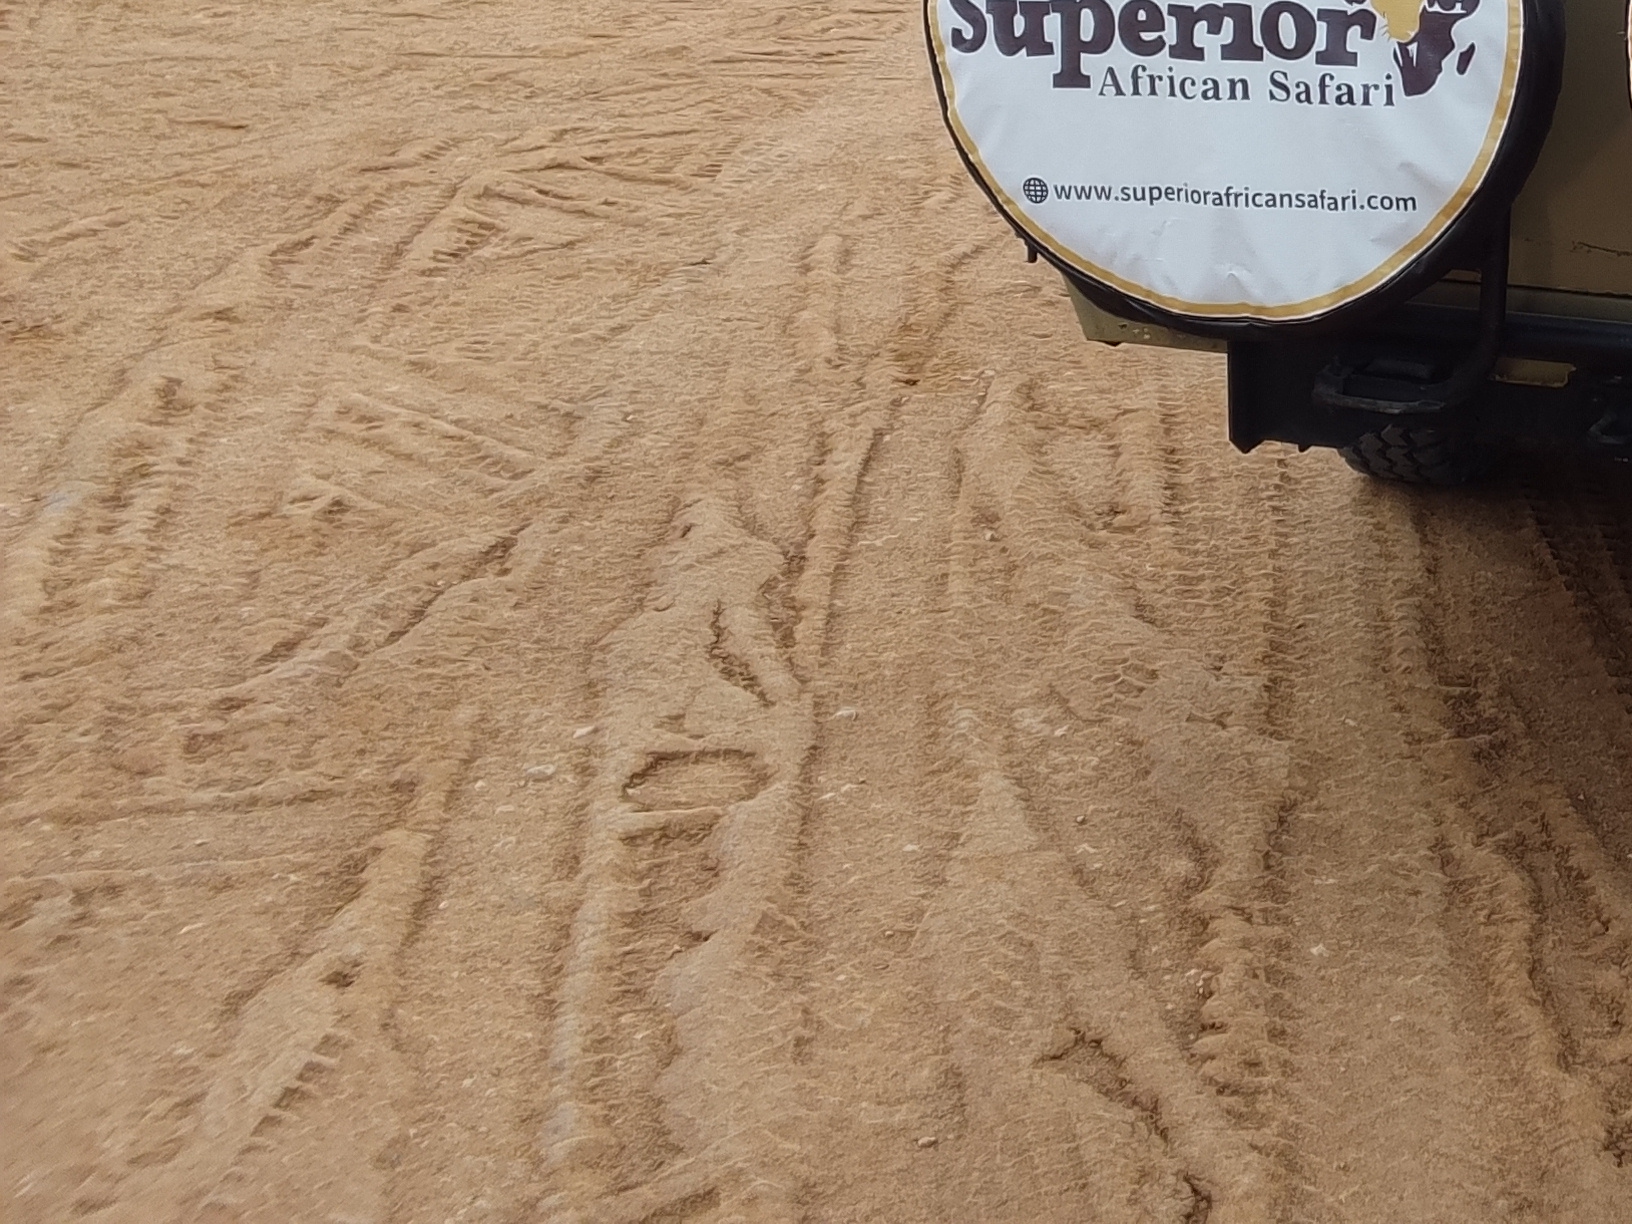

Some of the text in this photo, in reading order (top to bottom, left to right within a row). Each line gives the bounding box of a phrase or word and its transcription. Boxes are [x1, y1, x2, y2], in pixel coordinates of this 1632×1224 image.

[1097, 64, 1396, 108] African Safari
[1053, 178, 1418, 213] www.superiorafricansafari.com
